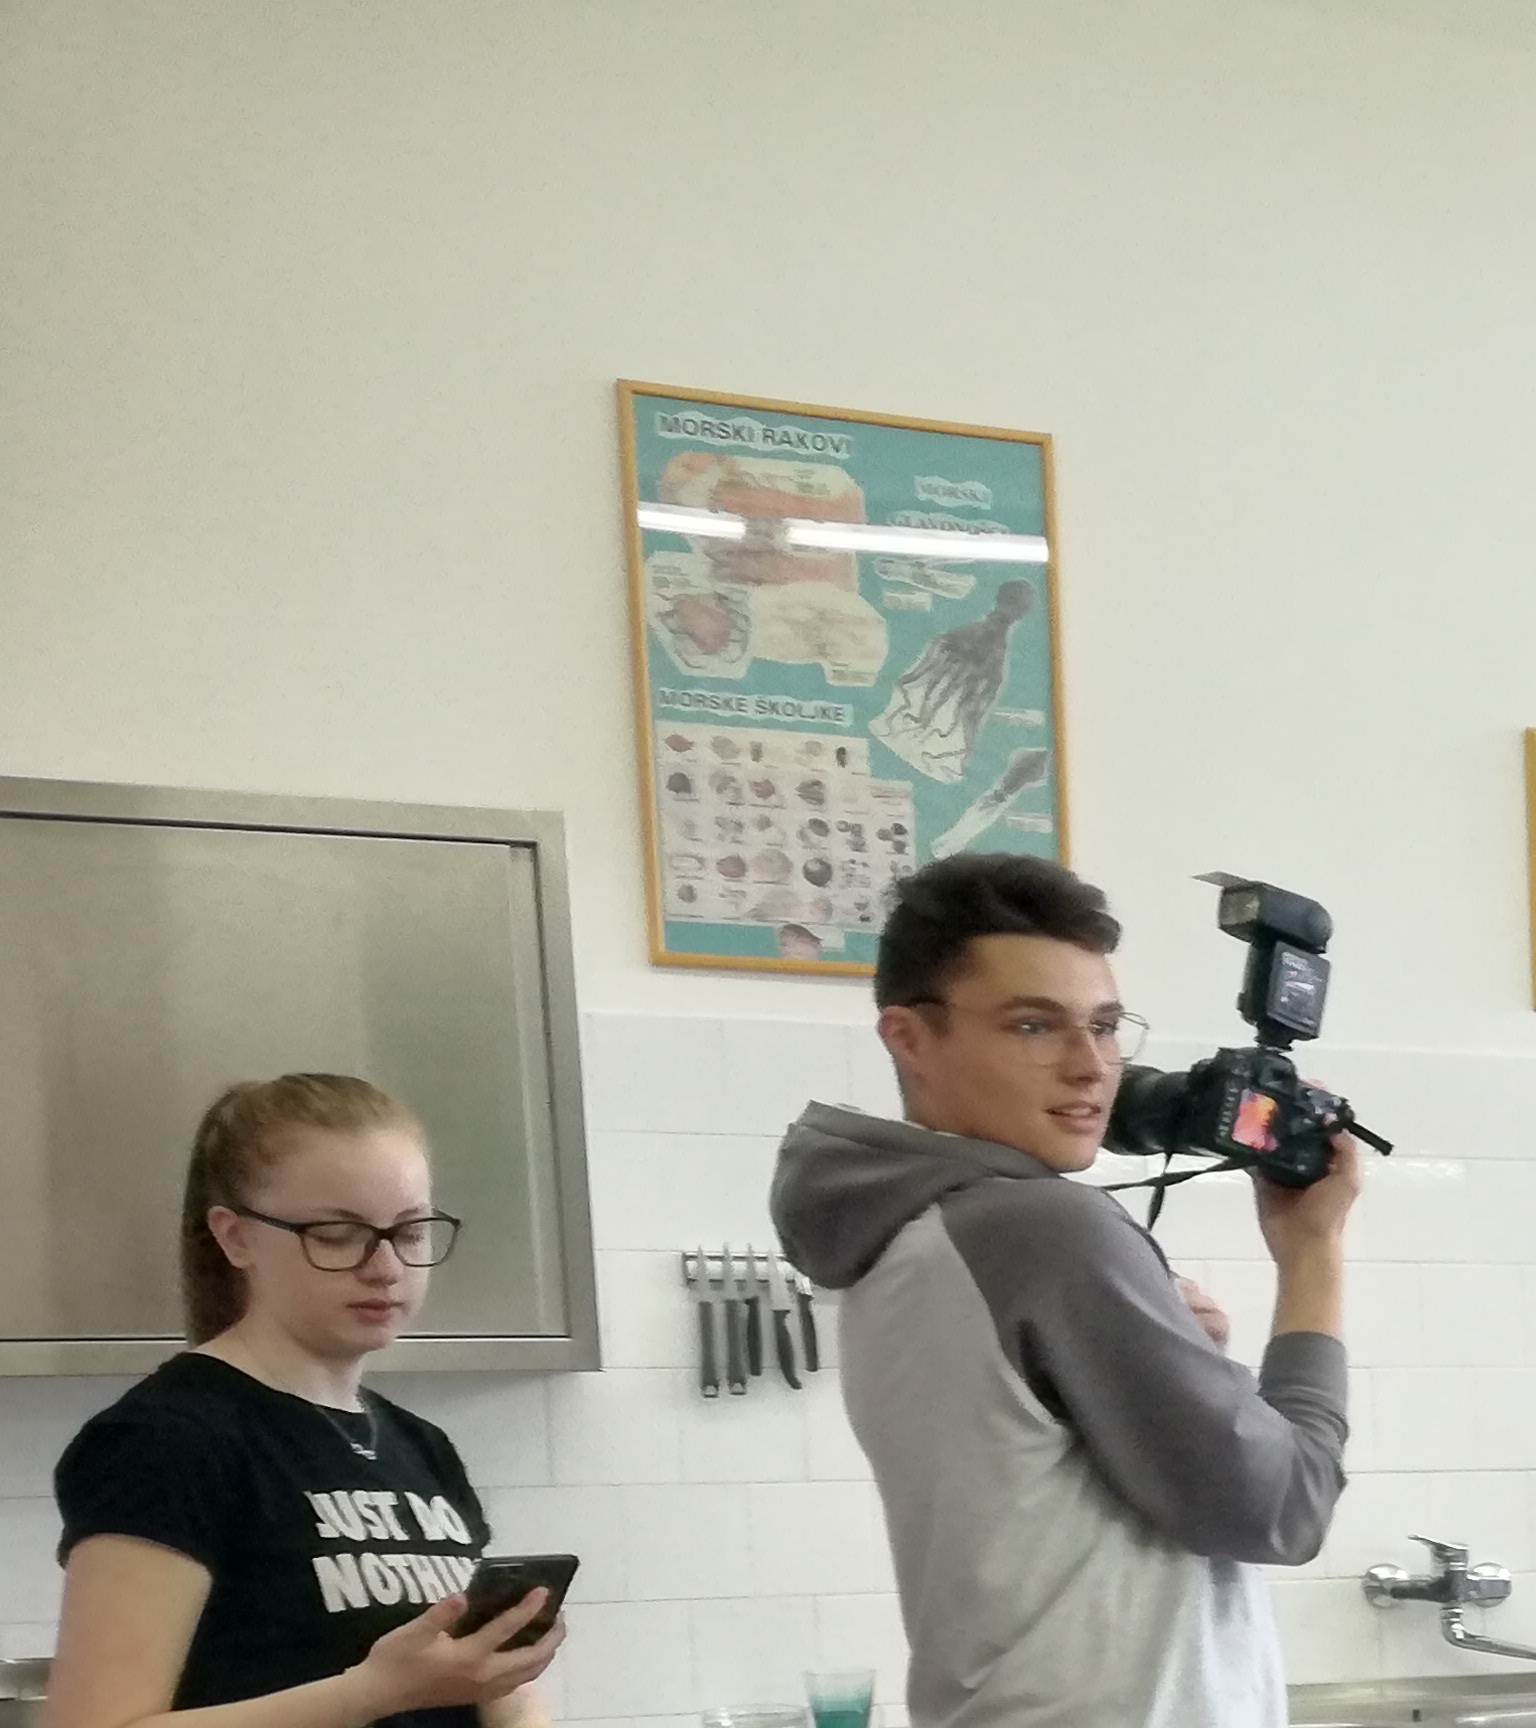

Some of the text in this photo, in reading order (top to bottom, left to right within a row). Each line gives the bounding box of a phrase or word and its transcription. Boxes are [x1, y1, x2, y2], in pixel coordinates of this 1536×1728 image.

[659, 413, 852, 455] MORSKI RAKOVI
[658, 689, 750, 714] MORSKE
[303, 1490, 472, 1544] JUST DO
[311, 1552, 482, 1613] NOTHIN
